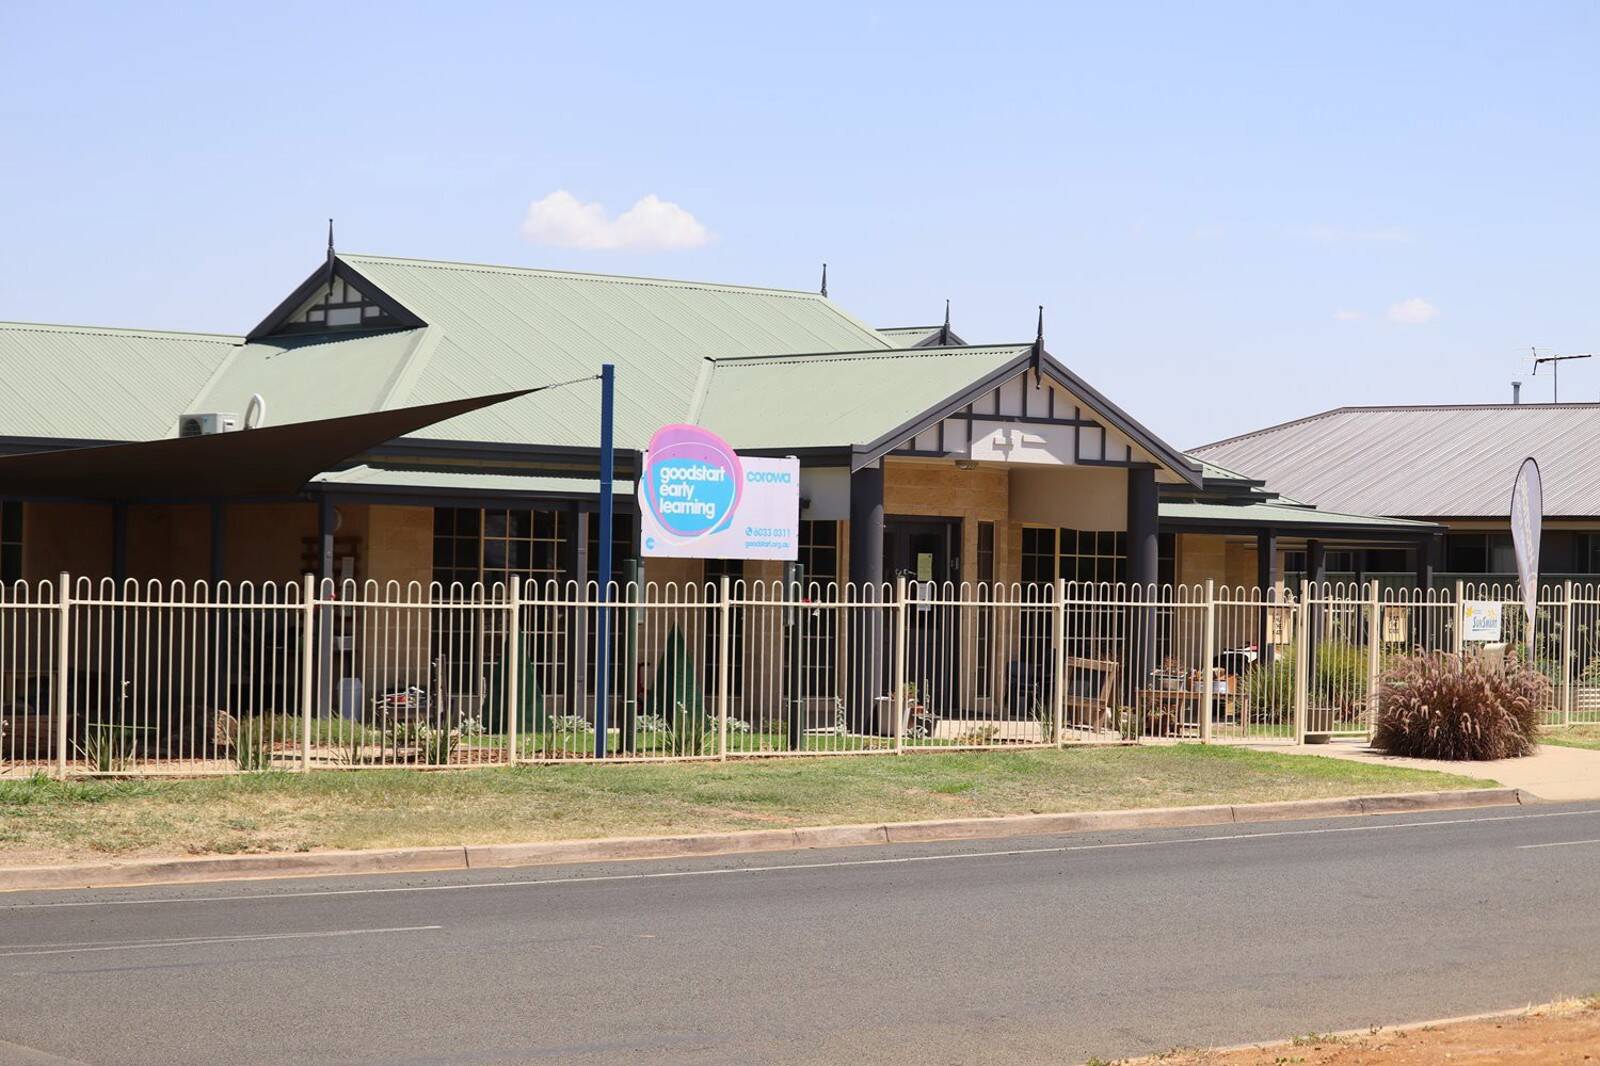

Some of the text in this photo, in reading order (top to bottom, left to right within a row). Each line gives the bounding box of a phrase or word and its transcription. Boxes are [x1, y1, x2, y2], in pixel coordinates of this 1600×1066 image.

[660, 465, 725, 482] goodstart
[746, 471, 791, 483] corowa
[659, 482, 694, 499] early
[659, 498, 716, 519] learning
[753, 527, 791, 537] 6033 0311
